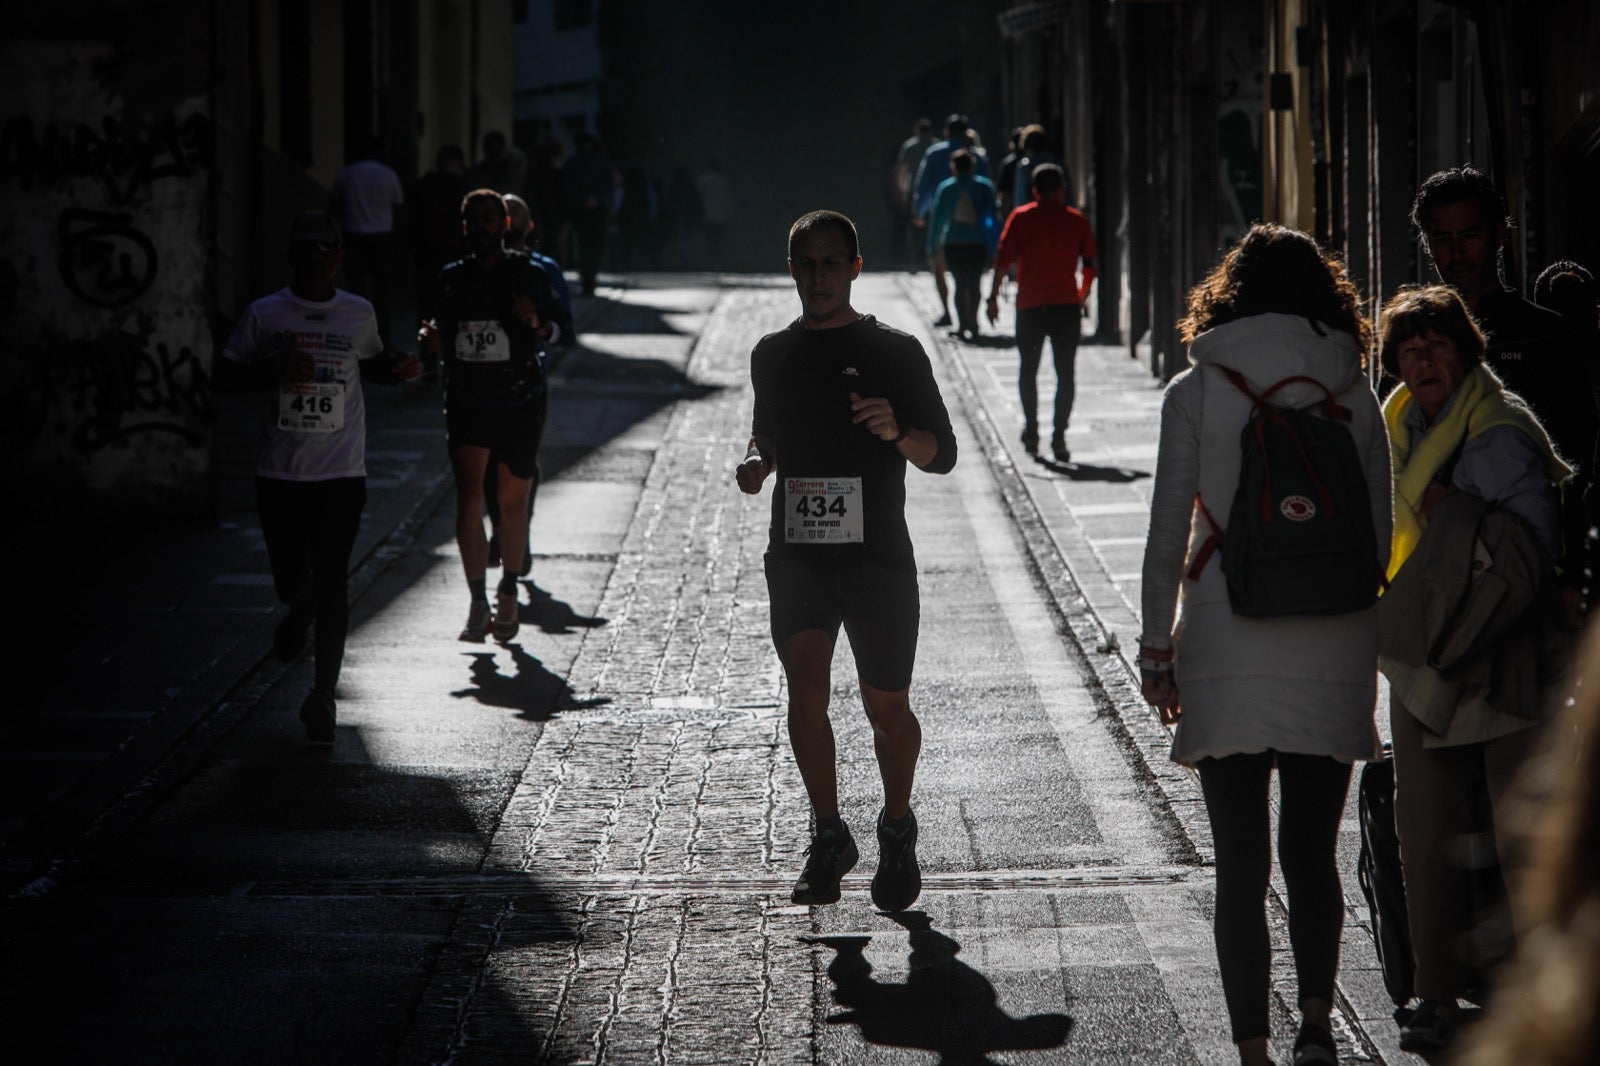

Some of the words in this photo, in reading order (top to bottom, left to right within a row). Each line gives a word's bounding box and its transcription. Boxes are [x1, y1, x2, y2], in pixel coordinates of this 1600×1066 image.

[466, 332, 496, 346] 130
[291, 396, 332, 413] 416
[795, 480, 825, 488] Carrera
[796, 495, 847, 517] 434
